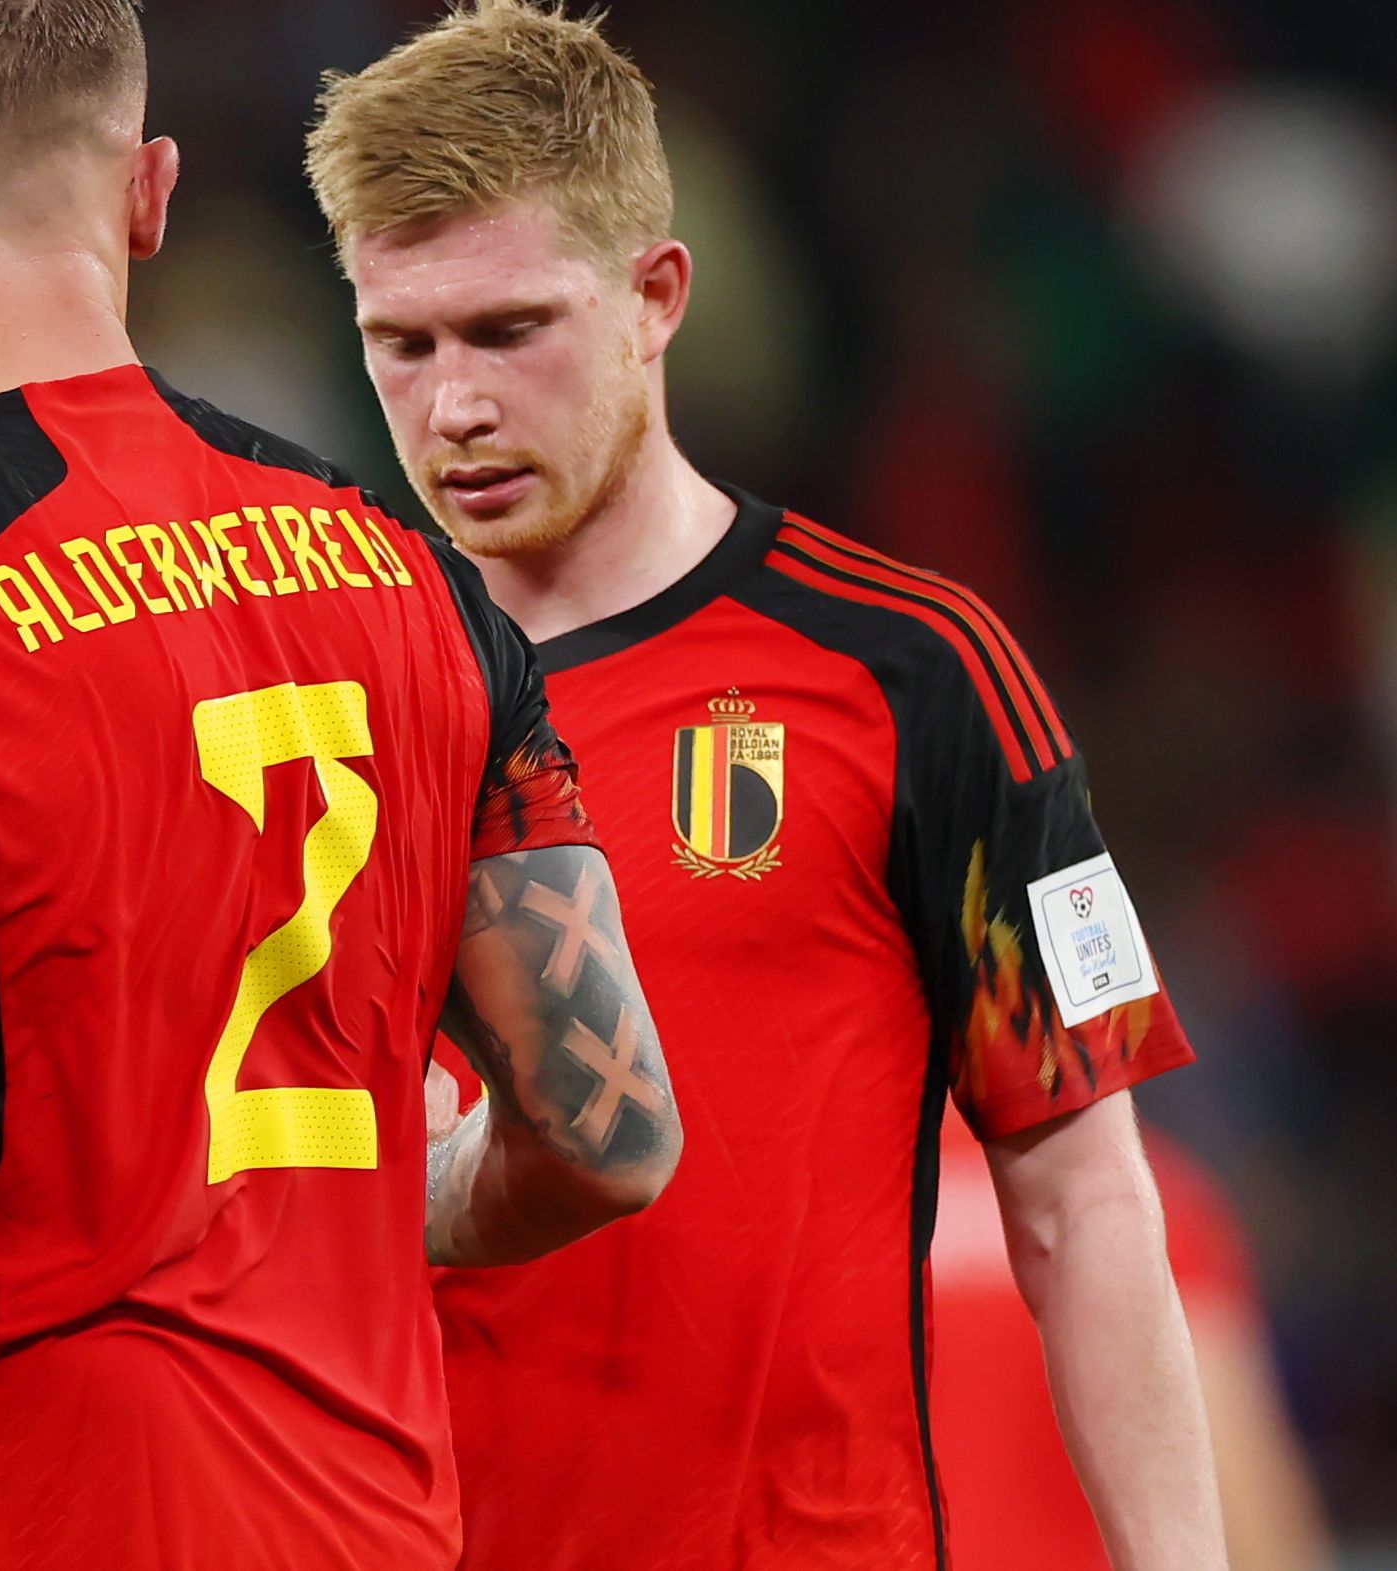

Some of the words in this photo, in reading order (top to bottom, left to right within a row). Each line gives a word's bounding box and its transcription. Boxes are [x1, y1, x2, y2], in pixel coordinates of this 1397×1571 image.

[731, 727, 767, 738] ROYAL
[731, 739, 779, 749] BELGIAN
[193, 681, 379, 1185] 2
[1075, 933, 1111, 961] UNITES
